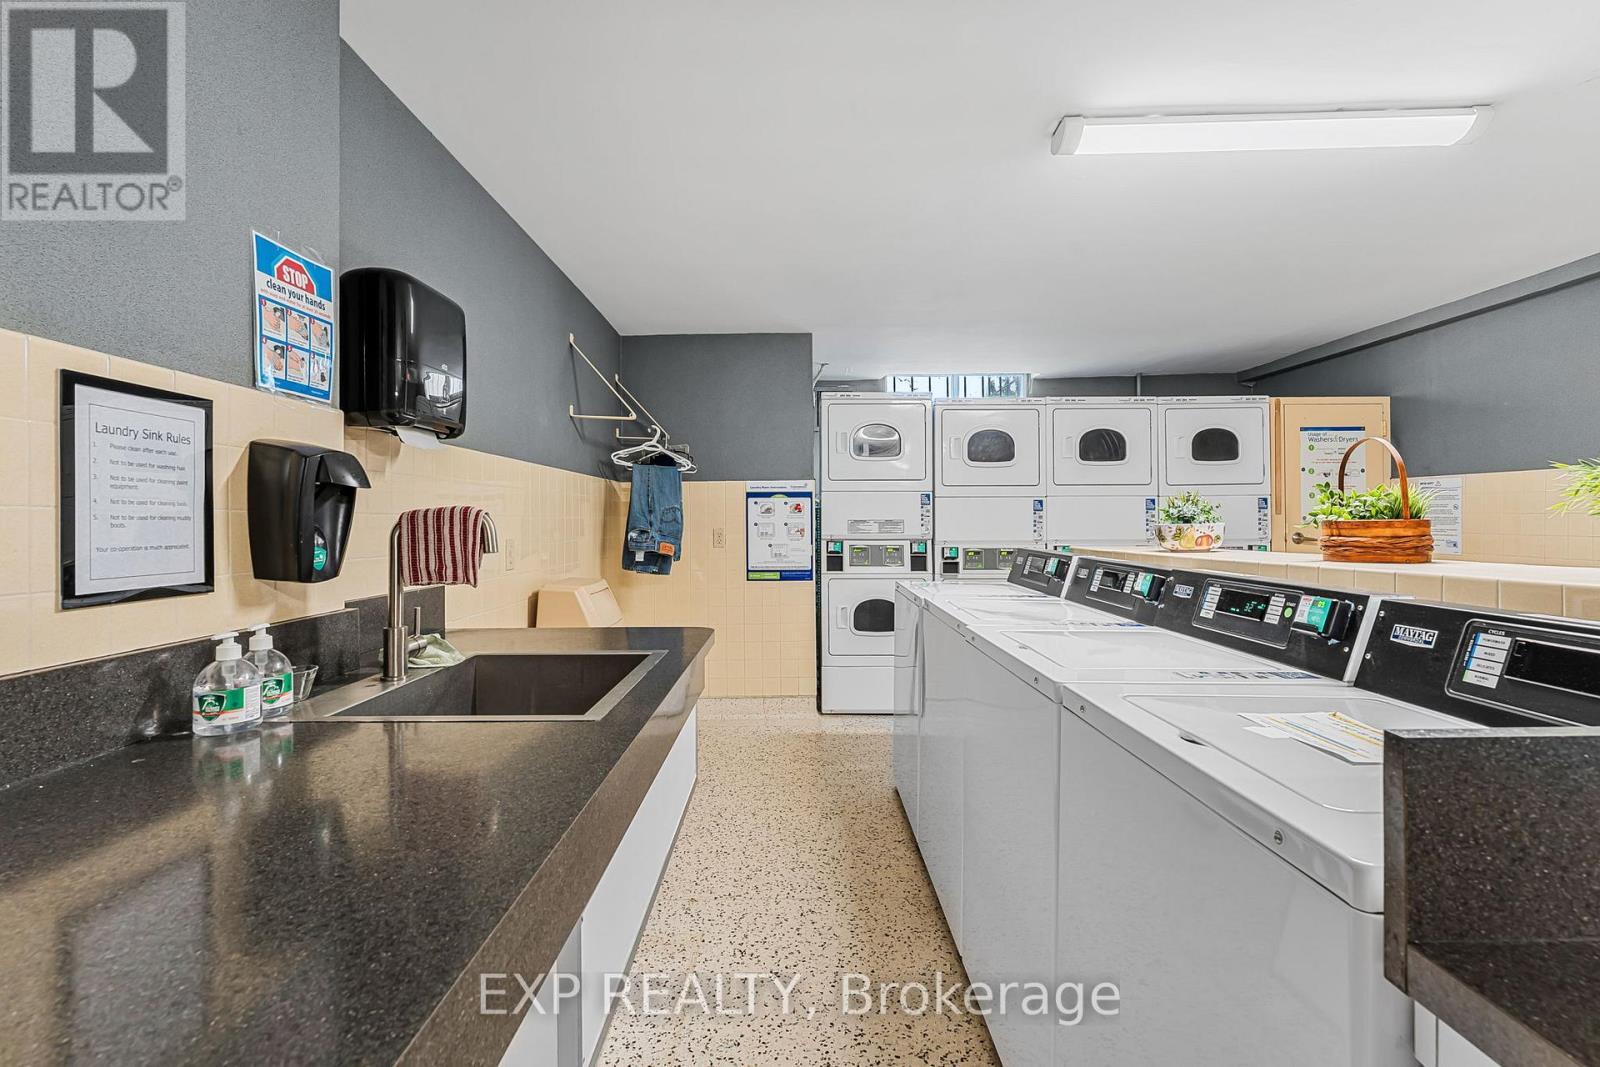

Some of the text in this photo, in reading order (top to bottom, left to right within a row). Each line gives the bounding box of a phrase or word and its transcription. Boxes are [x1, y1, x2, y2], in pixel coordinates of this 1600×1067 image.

[282, 264, 308, 290] STOP
[266, 279, 326, 310] clean your hands
[95, 422, 191, 445] Laundry Sink Rules
[1395, 626, 1434, 641] MAYTAG
